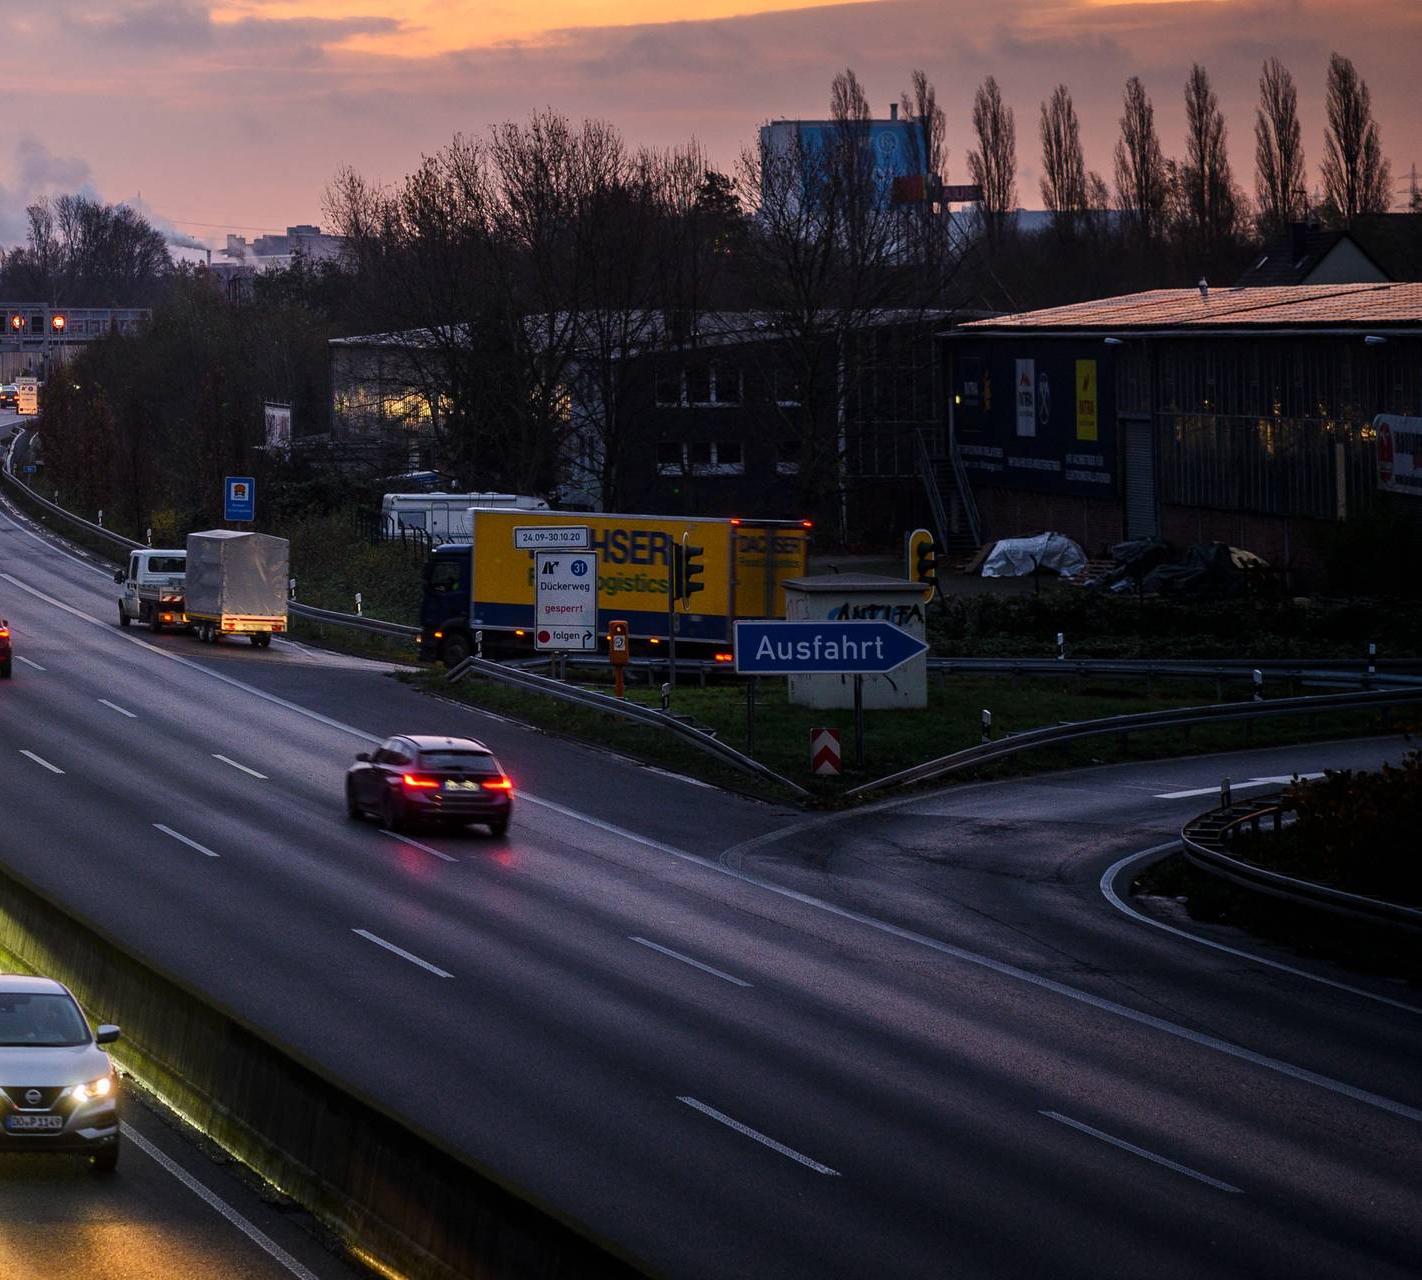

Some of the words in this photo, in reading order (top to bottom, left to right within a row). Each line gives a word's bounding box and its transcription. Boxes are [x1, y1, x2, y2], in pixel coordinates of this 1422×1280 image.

[522, 533, 581, 542] 24.09-30.10.20
[574, 564, 584, 573] 31
[540, 581, 590, 592] Dückerweg
[545, 605, 583, 614] gesperrt
[553, 631, 580, 641] folgen
[755, 634, 884, 661] Ausfahrt
